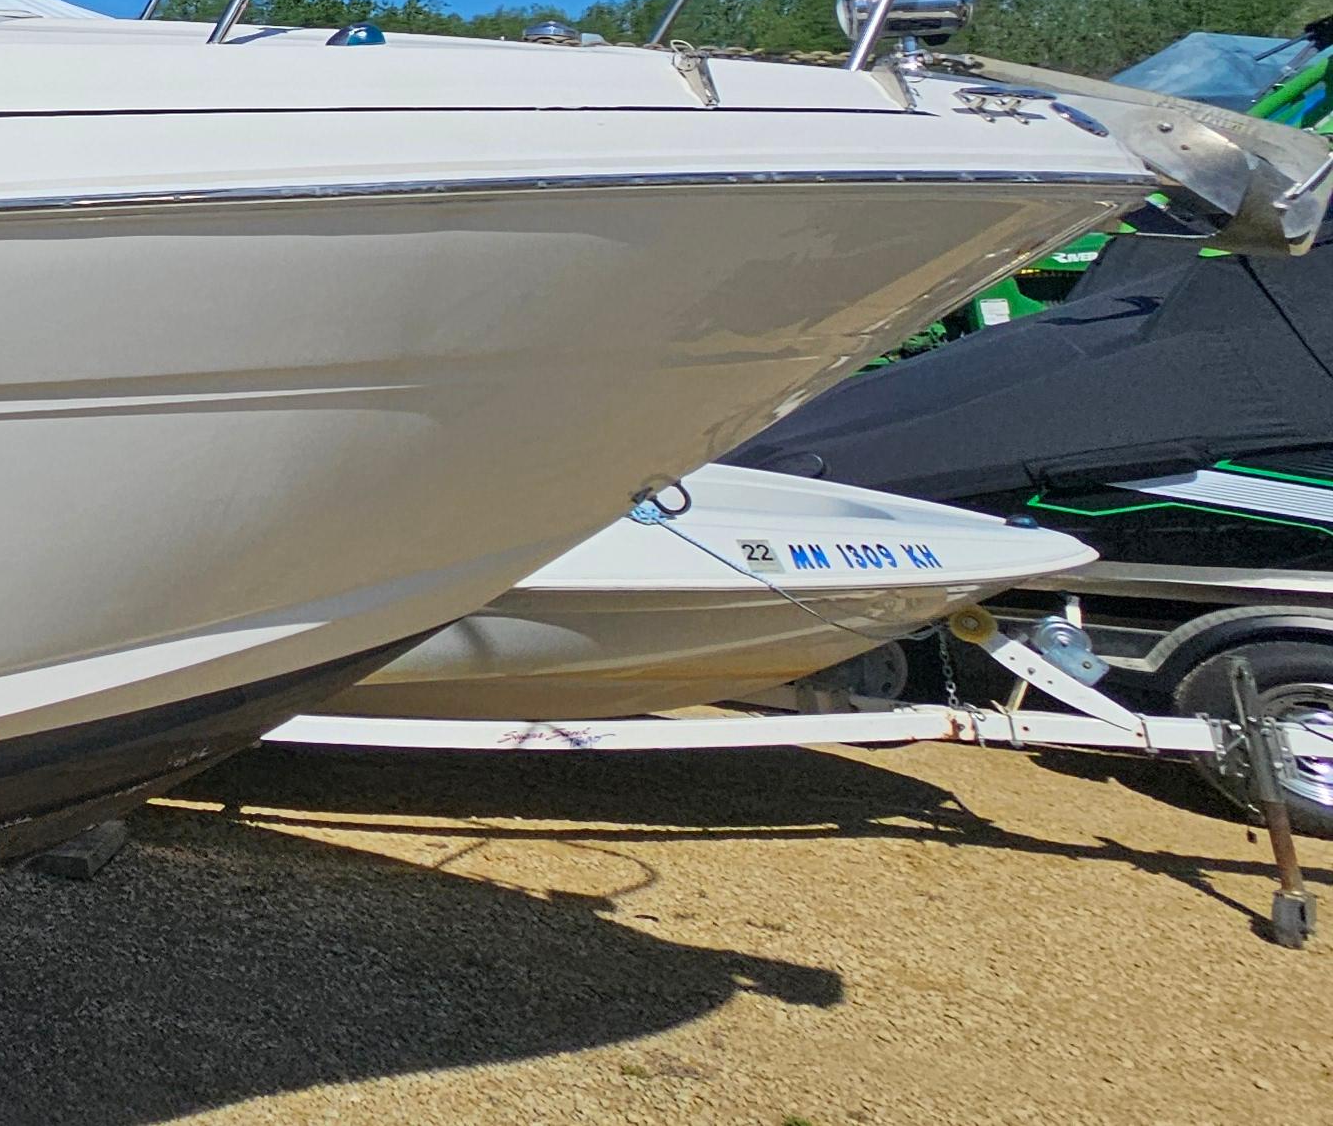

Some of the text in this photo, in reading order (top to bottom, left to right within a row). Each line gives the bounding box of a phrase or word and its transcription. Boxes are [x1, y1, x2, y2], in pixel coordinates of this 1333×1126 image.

[741, 544, 774, 561] 22
[788, 543, 943, 570] MN 1309 KH
